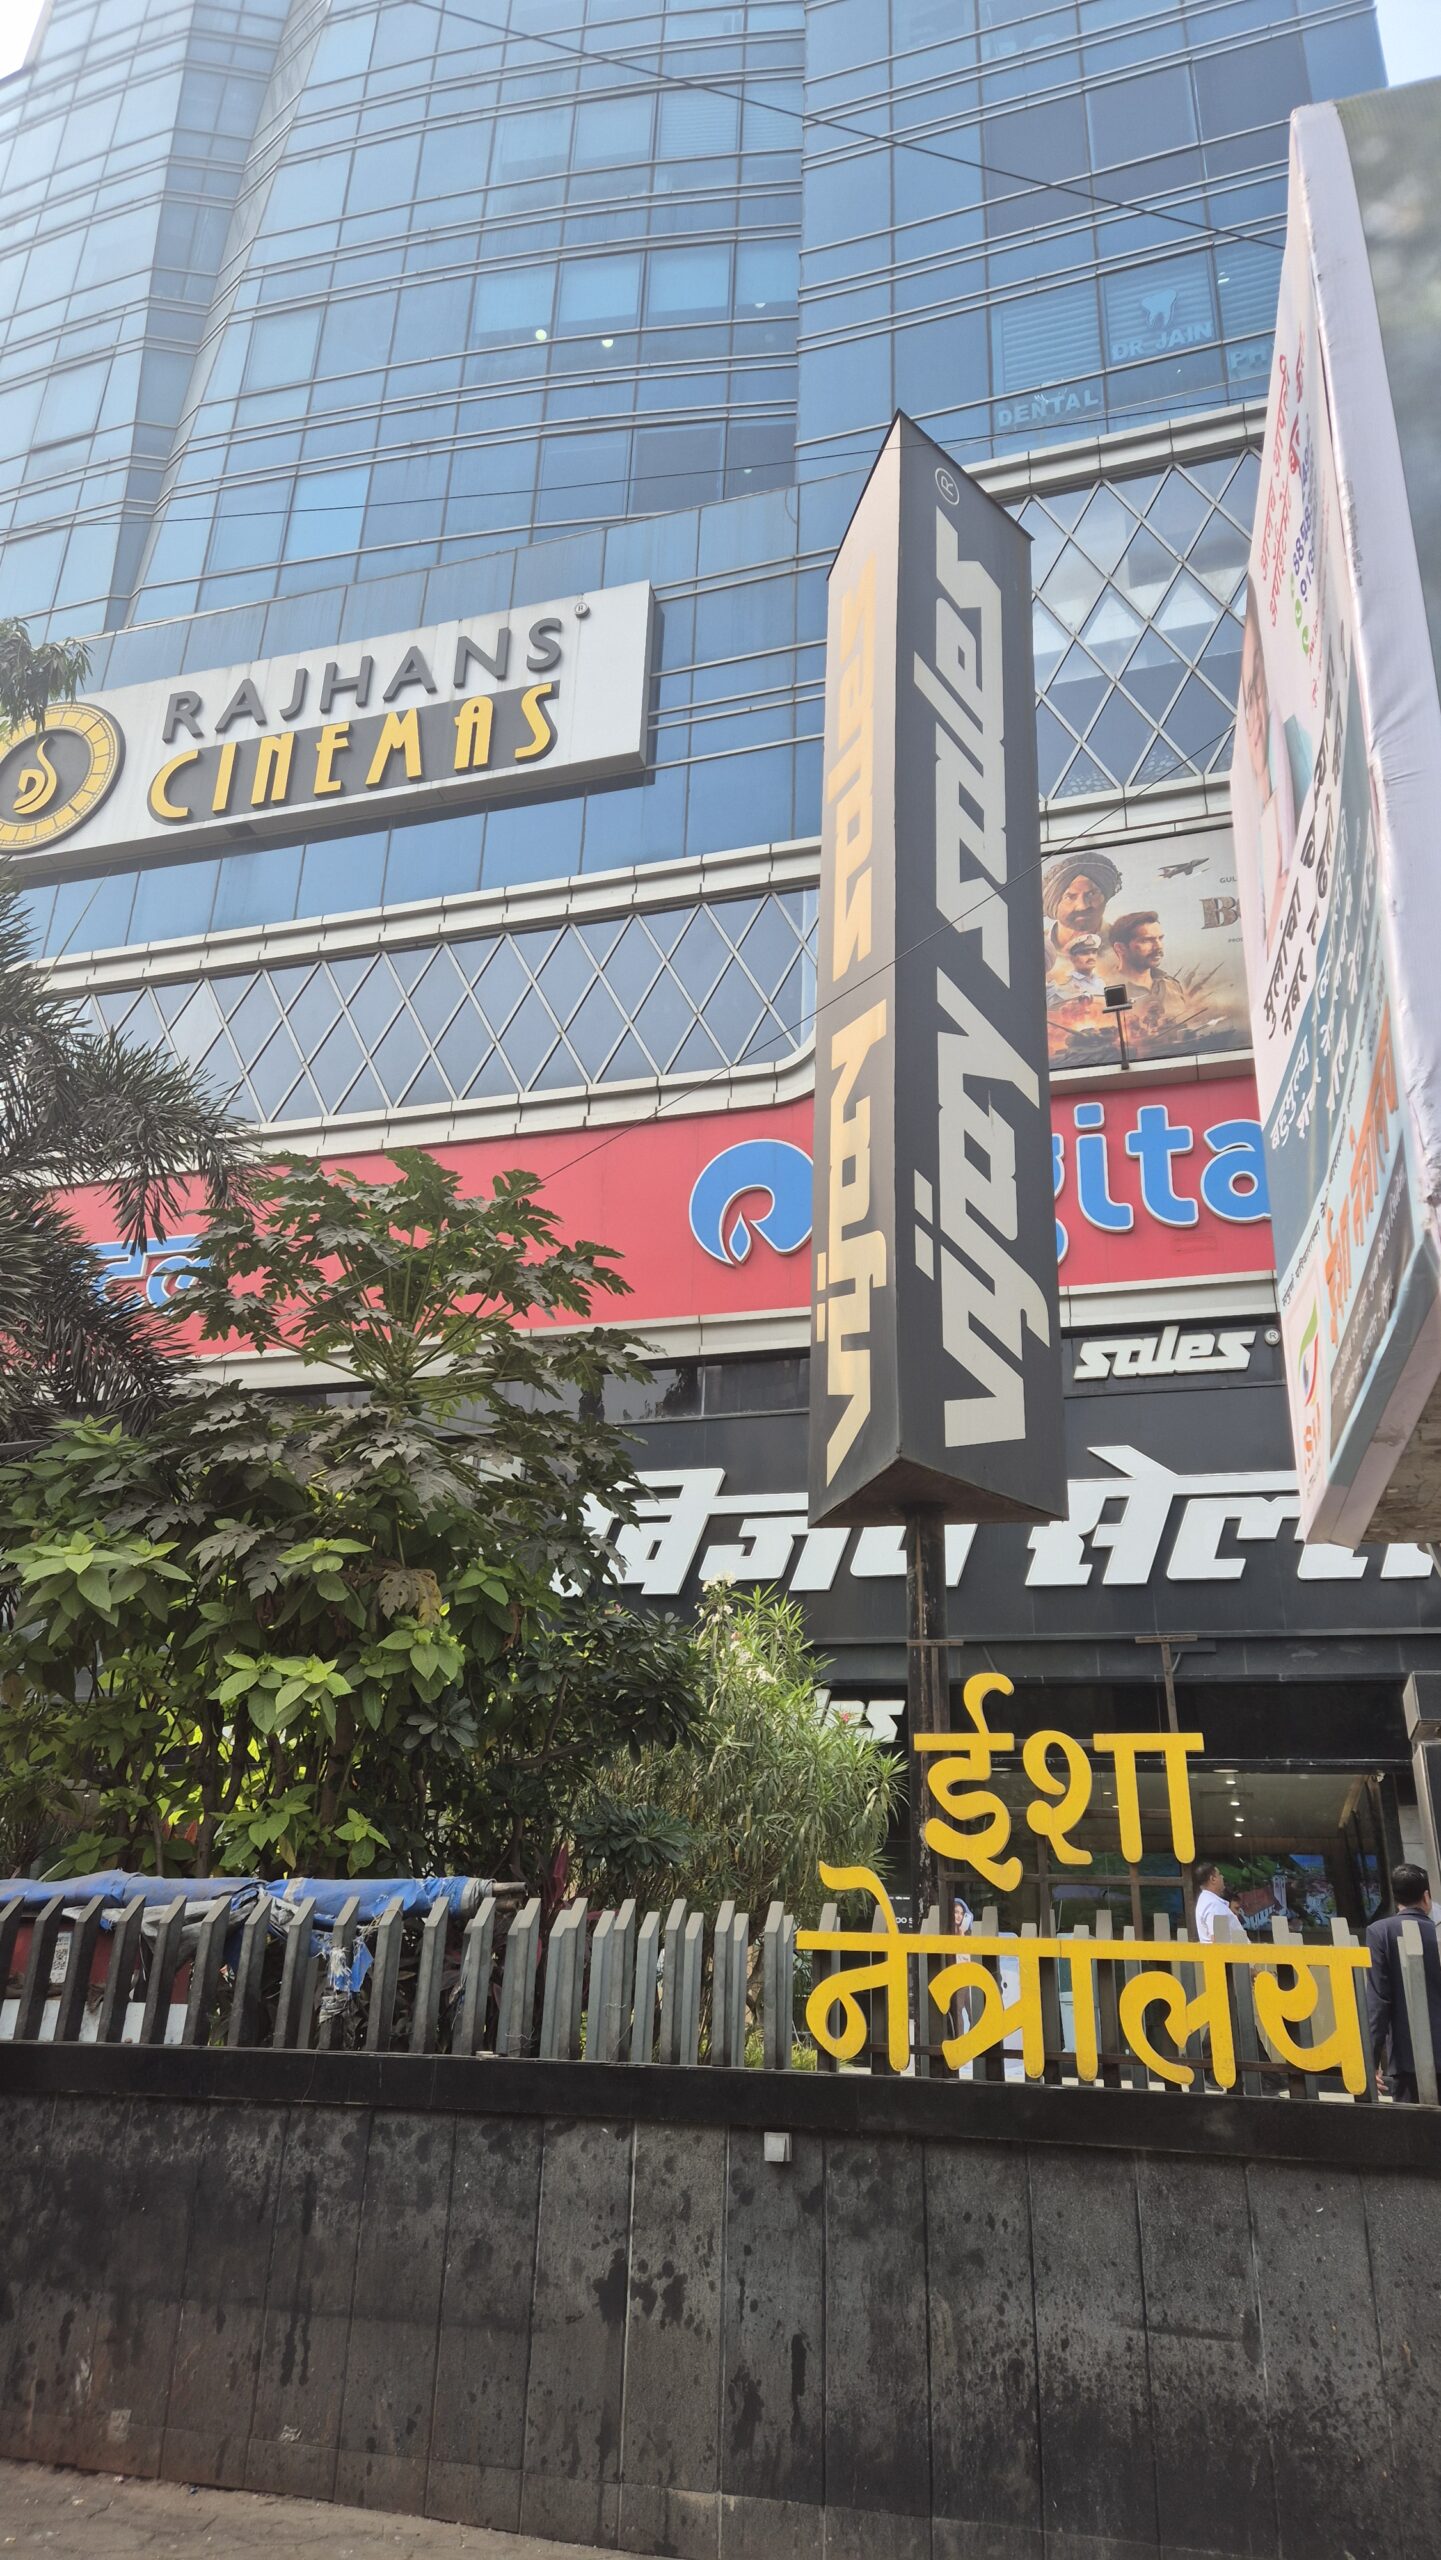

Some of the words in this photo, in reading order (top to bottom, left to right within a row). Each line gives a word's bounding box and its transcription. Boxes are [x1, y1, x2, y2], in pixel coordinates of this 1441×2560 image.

[1112, 340, 1145, 361] DR
[1156, 322, 1214, 353] JAIN
[998, 390, 1099, 428] DENTAL
[162, 617, 562, 743] RAJHANS
[149, 682, 553, 820] CINEMAS
[1199, 896, 1241, 929] B
[1281, 947, 1307, 1036] नंबर
[1074, 1326, 1257, 1381] sales
[914, 1673, 1205, 1892] ईशा
[796, 1861, 1372, 2095] नेत्रालय
